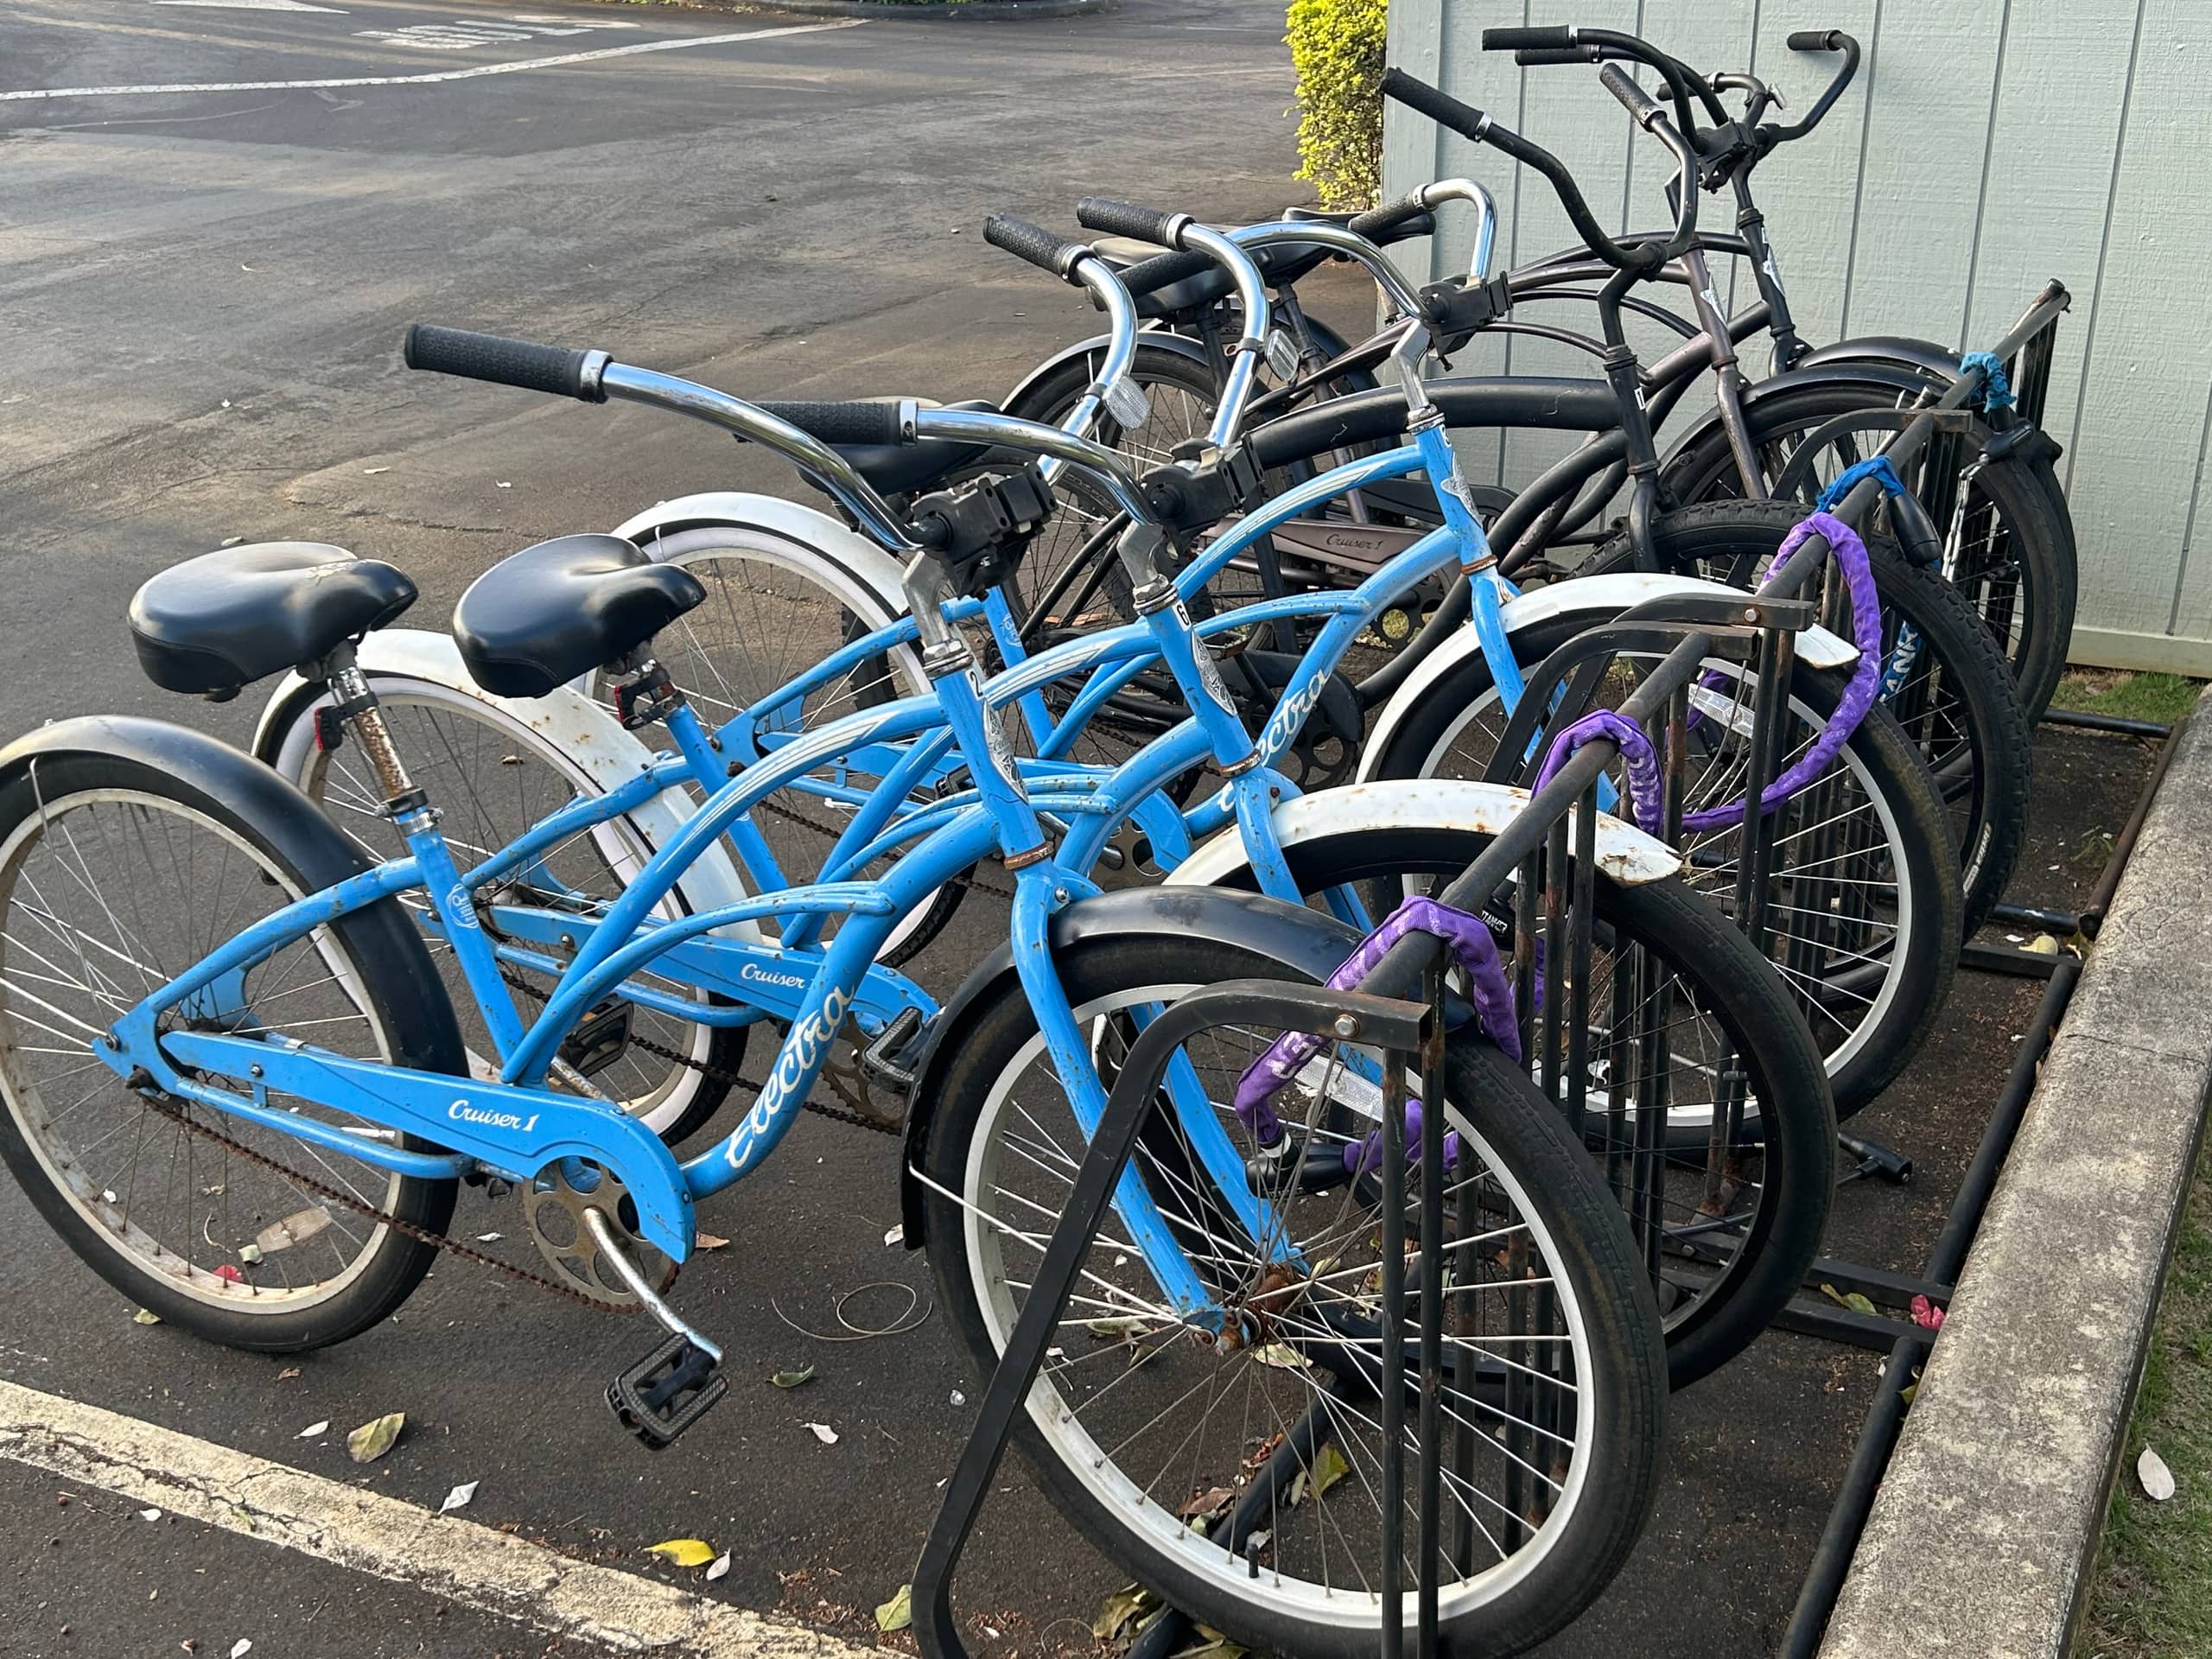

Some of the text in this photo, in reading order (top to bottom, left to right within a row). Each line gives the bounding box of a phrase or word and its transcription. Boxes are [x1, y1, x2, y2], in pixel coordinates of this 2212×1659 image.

[1176, 604, 1190, 626] 6
[969, 671, 983, 698] 2
[741, 963, 805, 989] Cruiser
[724, 982, 855, 1168] Electra
[448, 1098, 540, 1132] Cruiser 1
